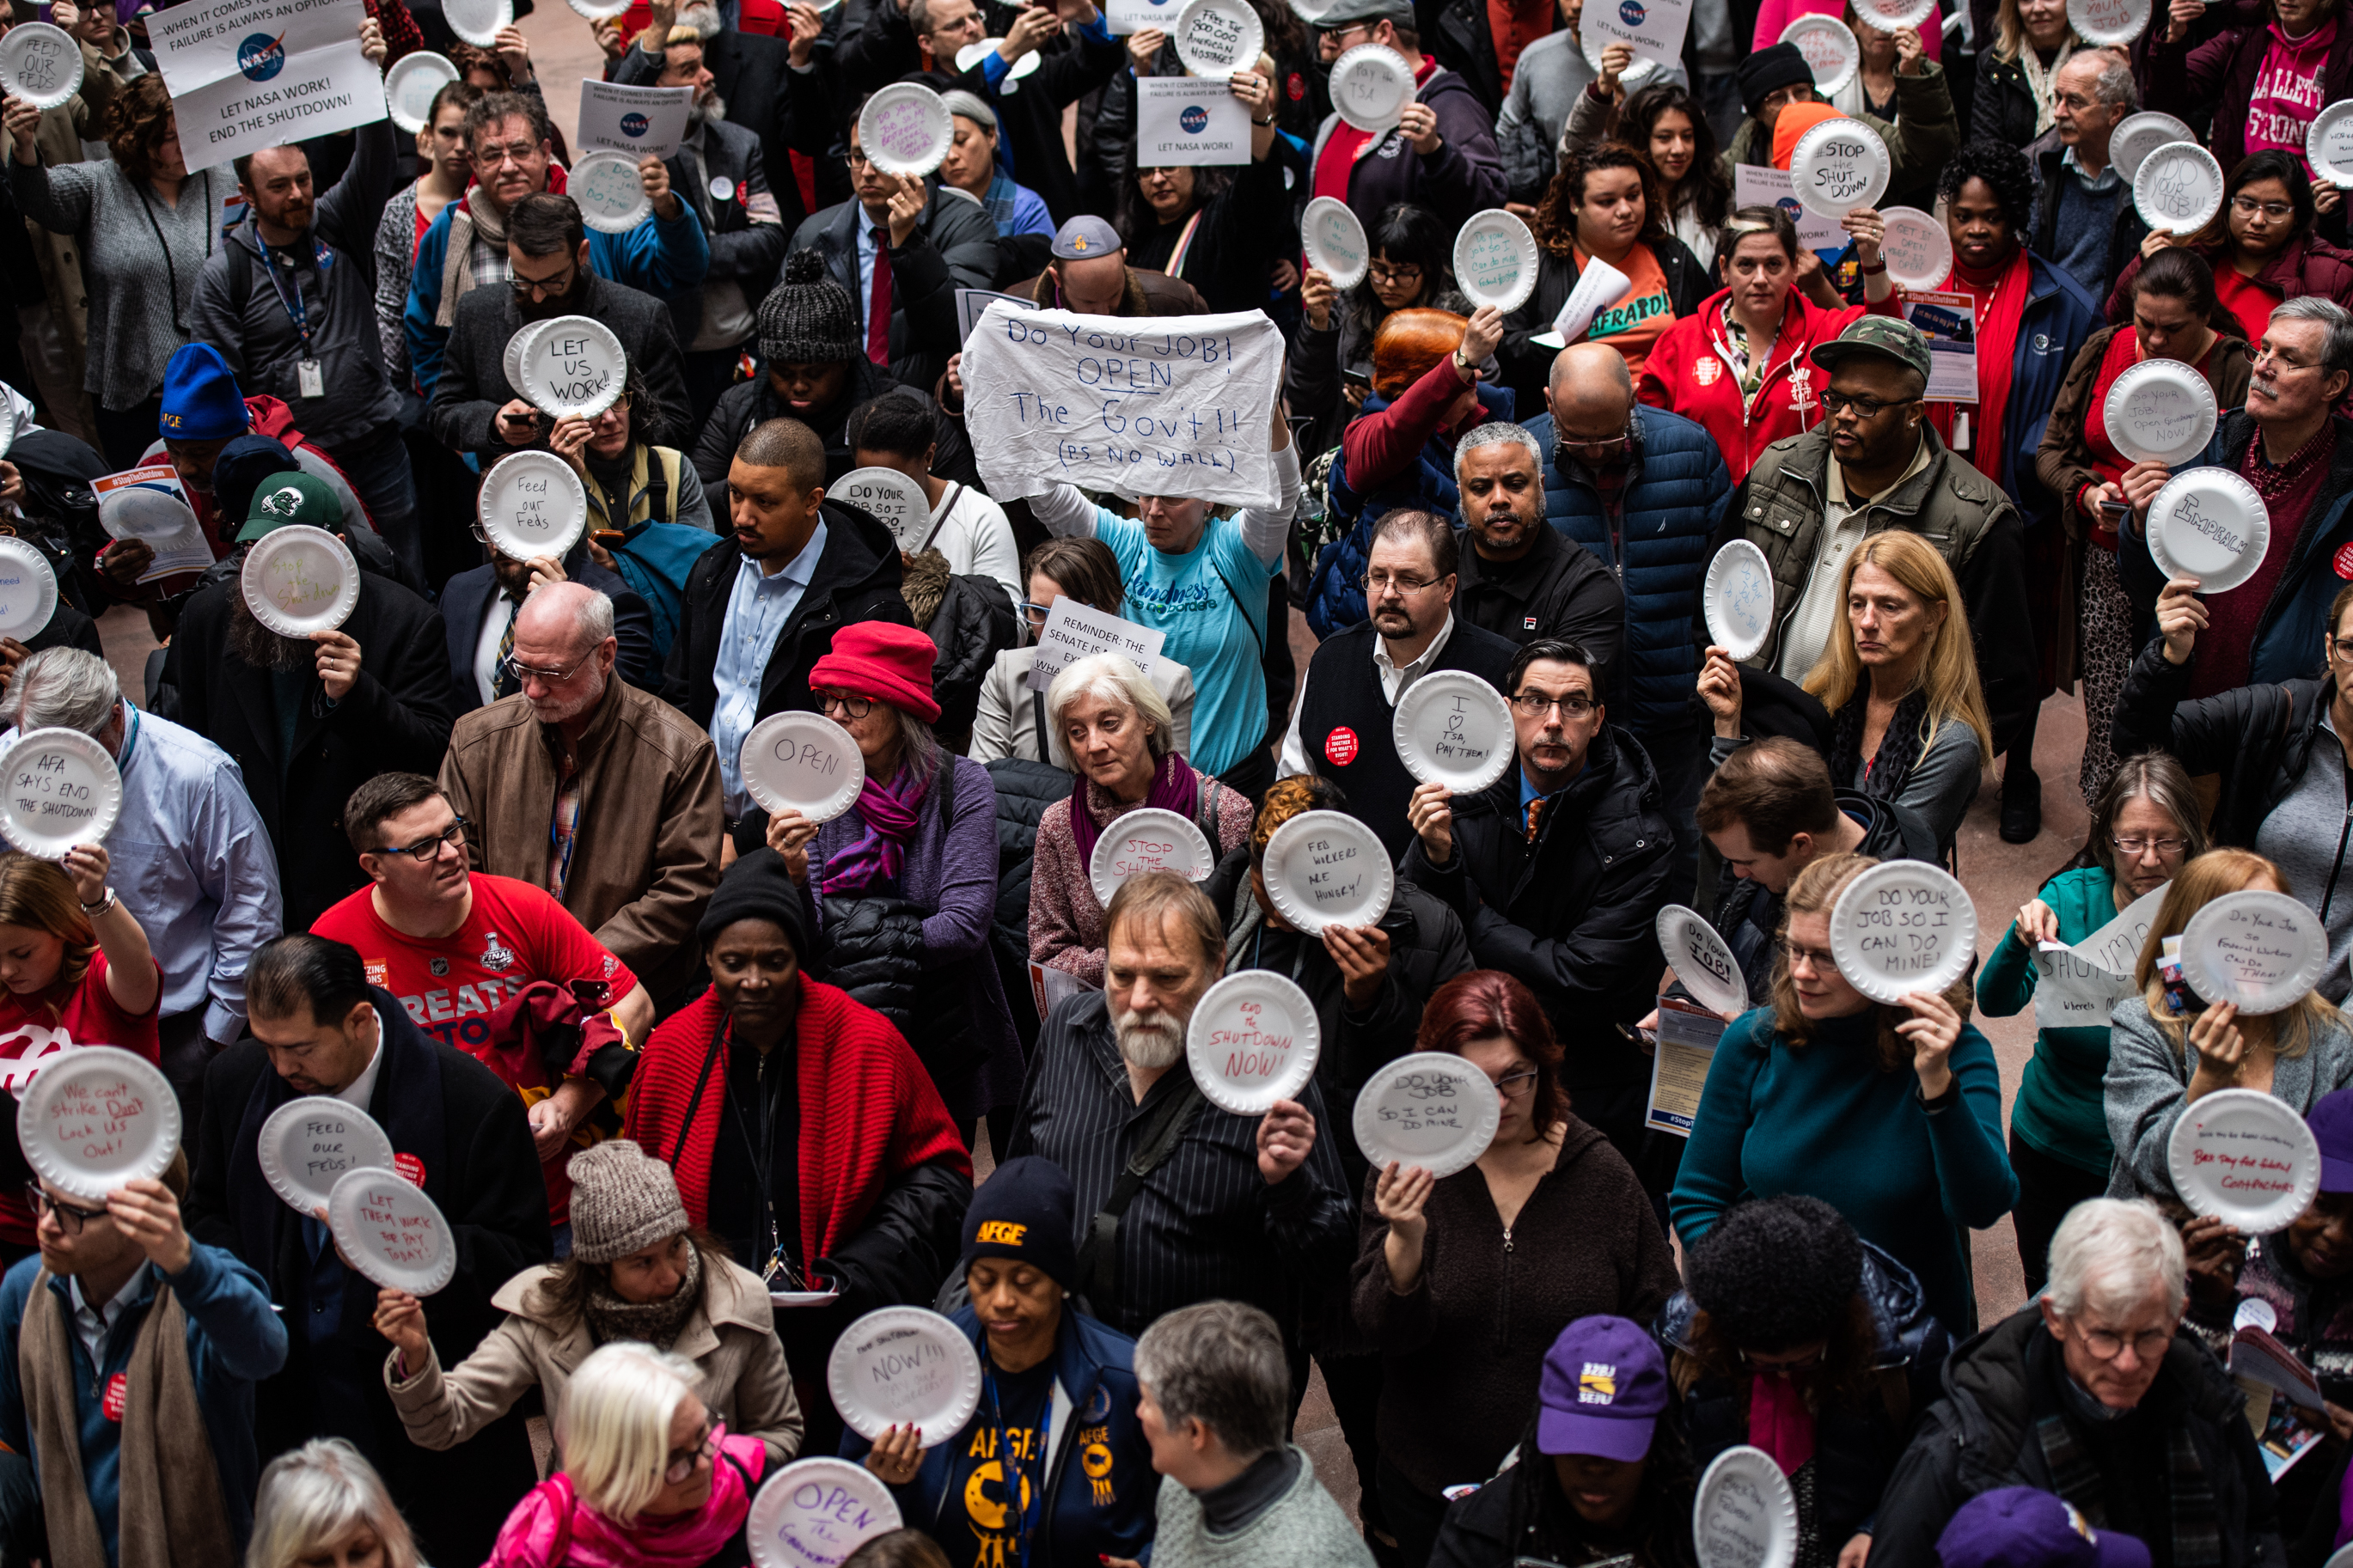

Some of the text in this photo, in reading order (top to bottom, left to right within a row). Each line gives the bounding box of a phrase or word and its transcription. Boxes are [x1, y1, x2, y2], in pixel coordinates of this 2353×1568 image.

[162, 0, 253, 36] WHEN IT COMES
[1202, 9, 1226, 27] FREE
[2090, 11, 2130, 29] JOB
[169, 6, 294, 52] FAILURE IS ALWAYS AN
[1597, 20, 1665, 50] LET NASA WORK!
[27, 40, 61, 58] FEED
[1187, 32, 1234, 53] AMERICAN
[25, 53, 57, 76] OUR
[241, 48, 284, 71] NASA
[1191, 46, 1235, 65] HOSTAGES
[19, 72, 55, 89] FEDS
[220, 77, 331, 119] LET NASA WORK!
[1349, 84, 1374, 102] TSA
[210, 92, 353, 143] END THE SHUTDOWN!
[622, 121, 646, 130] NASA
[1183, 115, 1207, 125] NASA
[597, 137, 668, 154] LET NASA WORK!
[1158, 142, 1233, 152] LET NASA WORK!
[1815, 142, 1865, 158] #STOP
[613, 163, 633, 178] DO
[1815, 168, 1855, 186] SHUT
[2163, 156, 2198, 186] DO
[586, 188, 604, 202] DO
[1831, 177, 1867, 198] DOWN
[1797, 231, 1830, 240] WORK!
[1907, 291, 1960, 305] #StopTheShutdown
[551, 339, 590, 357] LET
[1008, 320, 1232, 375] Do Your JOB!
[565, 360, 592, 376] US
[1077, 357, 1171, 389] OPEN
[1010, 393, 1068, 424] The
[1107, 447, 1141, 464] NO
[113, 469, 166, 486] #StopTheShutdown
[517, 476, 547, 496] Feed
[850, 485, 907, 502] DO YOUR
[523, 500, 545, 513] our
[874, 503, 907, 514] SO I
[516, 511, 549, 530] Feds
[2173, 493, 2248, 555] IMPEACH
[272, 557, 303, 574] Stop
[288, 576, 312, 589] the
[1133, 574, 1212, 605] kindness
[1167, 597, 1217, 613] borders
[1048, 628, 1099, 655] SENATE IS
[1063, 616, 1146, 655] REMINDER: THE
[1452, 696, 1470, 713] I
[775, 739, 840, 776] OPEN
[1435, 742, 1489, 760] PAY THEM!
[38, 754, 67, 775] AFA
[16, 773, 89, 800] SAYS END
[17, 799, 98, 821] THE SHUTDOWN!
[1125, 839, 1174, 855] STOP
[1307, 839, 1330, 853] FED
[1137, 856, 1163, 866] THE
[1311, 847, 1358, 867] WORKERS
[1307, 872, 1329, 887] ARE
[1315, 874, 1362, 903] HUNGRY!
[1878, 888, 1950, 909] DO YOUR
[1856, 911, 1948, 929] JOB SO I
[2228, 910, 2274, 929] Do Your
[1689, 923, 1731, 958] Do Your
[1861, 933, 1938, 951] CAN DO
[481, 949, 513, 962] FINAL
[1690, 943, 1731, 983] JOB!
[1884, 953, 1940, 972] MINE!
[1240, 1002, 1262, 1016] END
[1209, 1030, 1293, 1051] SHUTDOWN
[1225, 1052, 1284, 1078] NOW!
[1393, 1073, 1470, 1090] DO YOUR
[63, 1083, 128, 1100] We can't
[1408, 1086, 1458, 1101] JOB
[1378, 1105, 1458, 1121] SO I CAN
[307, 1121, 345, 1137] FEED
[1403, 1119, 1463, 1131] DO MINE
[84, 1140, 123, 1158] Out!
[312, 1144, 344, 1154] OUR
[307, 1156, 356, 1175] FEDS!
[368, 1192, 395, 1209] LET
[360, 1208, 431, 1230] THEM WORK
[381, 1231, 425, 1246] FOR PAY
[975, 1219, 1028, 1246] AFGE
[383, 1246, 432, 1262] TODAY!
[1580, 1362, 1617, 1377] 32BJ
[1577, 1391, 1615, 1406] SEIU
[1079, 1425, 1110, 1446] AFGE
[794, 1483, 877, 1531] OPEN
